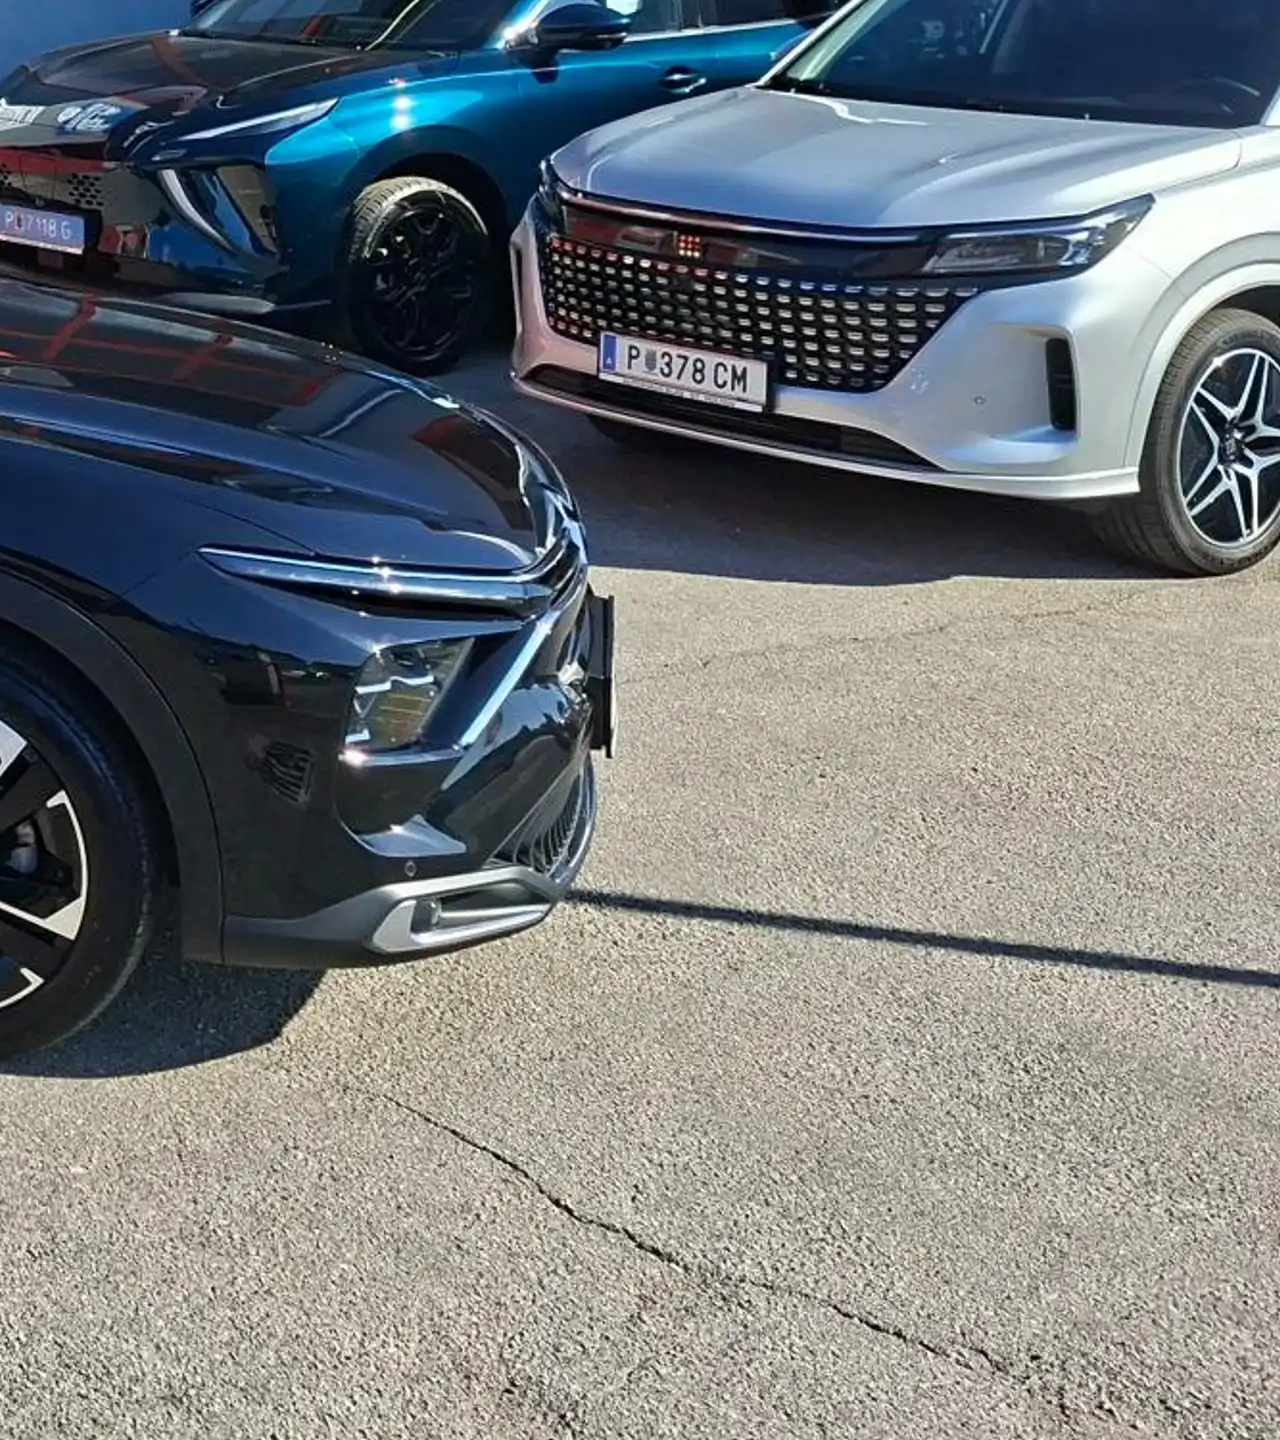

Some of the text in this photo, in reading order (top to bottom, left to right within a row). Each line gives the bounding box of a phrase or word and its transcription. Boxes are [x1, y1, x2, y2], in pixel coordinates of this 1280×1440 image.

[626, 344, 641, 370] P
[659, 351, 706, 385] 378
[713, 361, 748, 394] CM
